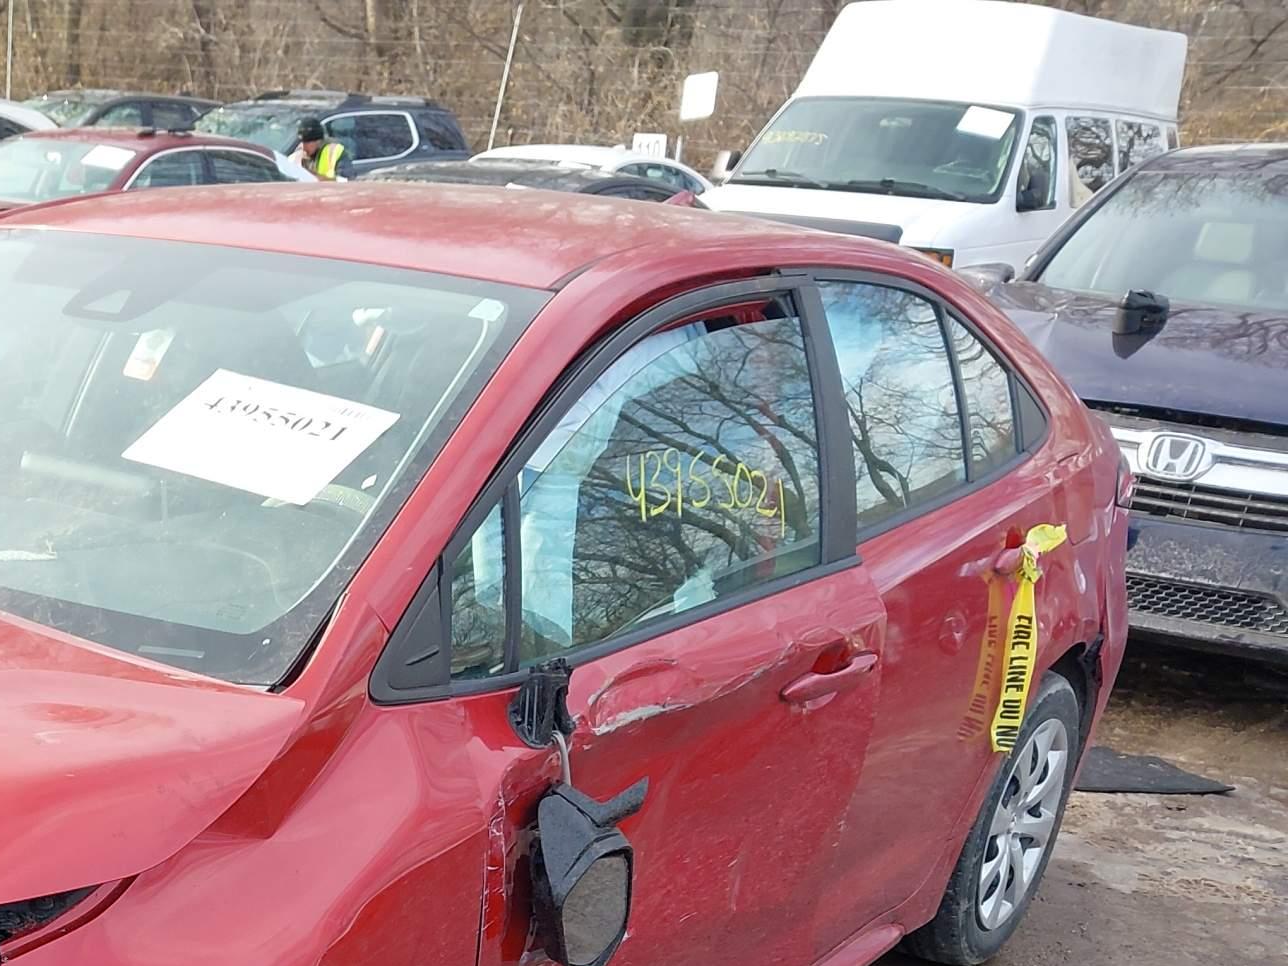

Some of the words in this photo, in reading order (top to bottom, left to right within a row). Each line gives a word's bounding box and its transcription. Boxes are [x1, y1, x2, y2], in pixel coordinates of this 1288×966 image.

[204, 396, 348, 441] 43955021
[1012, 614, 1033, 650] FIRE
[1005, 656, 1029, 693] LINE
[999, 698, 1023, 720] DO
